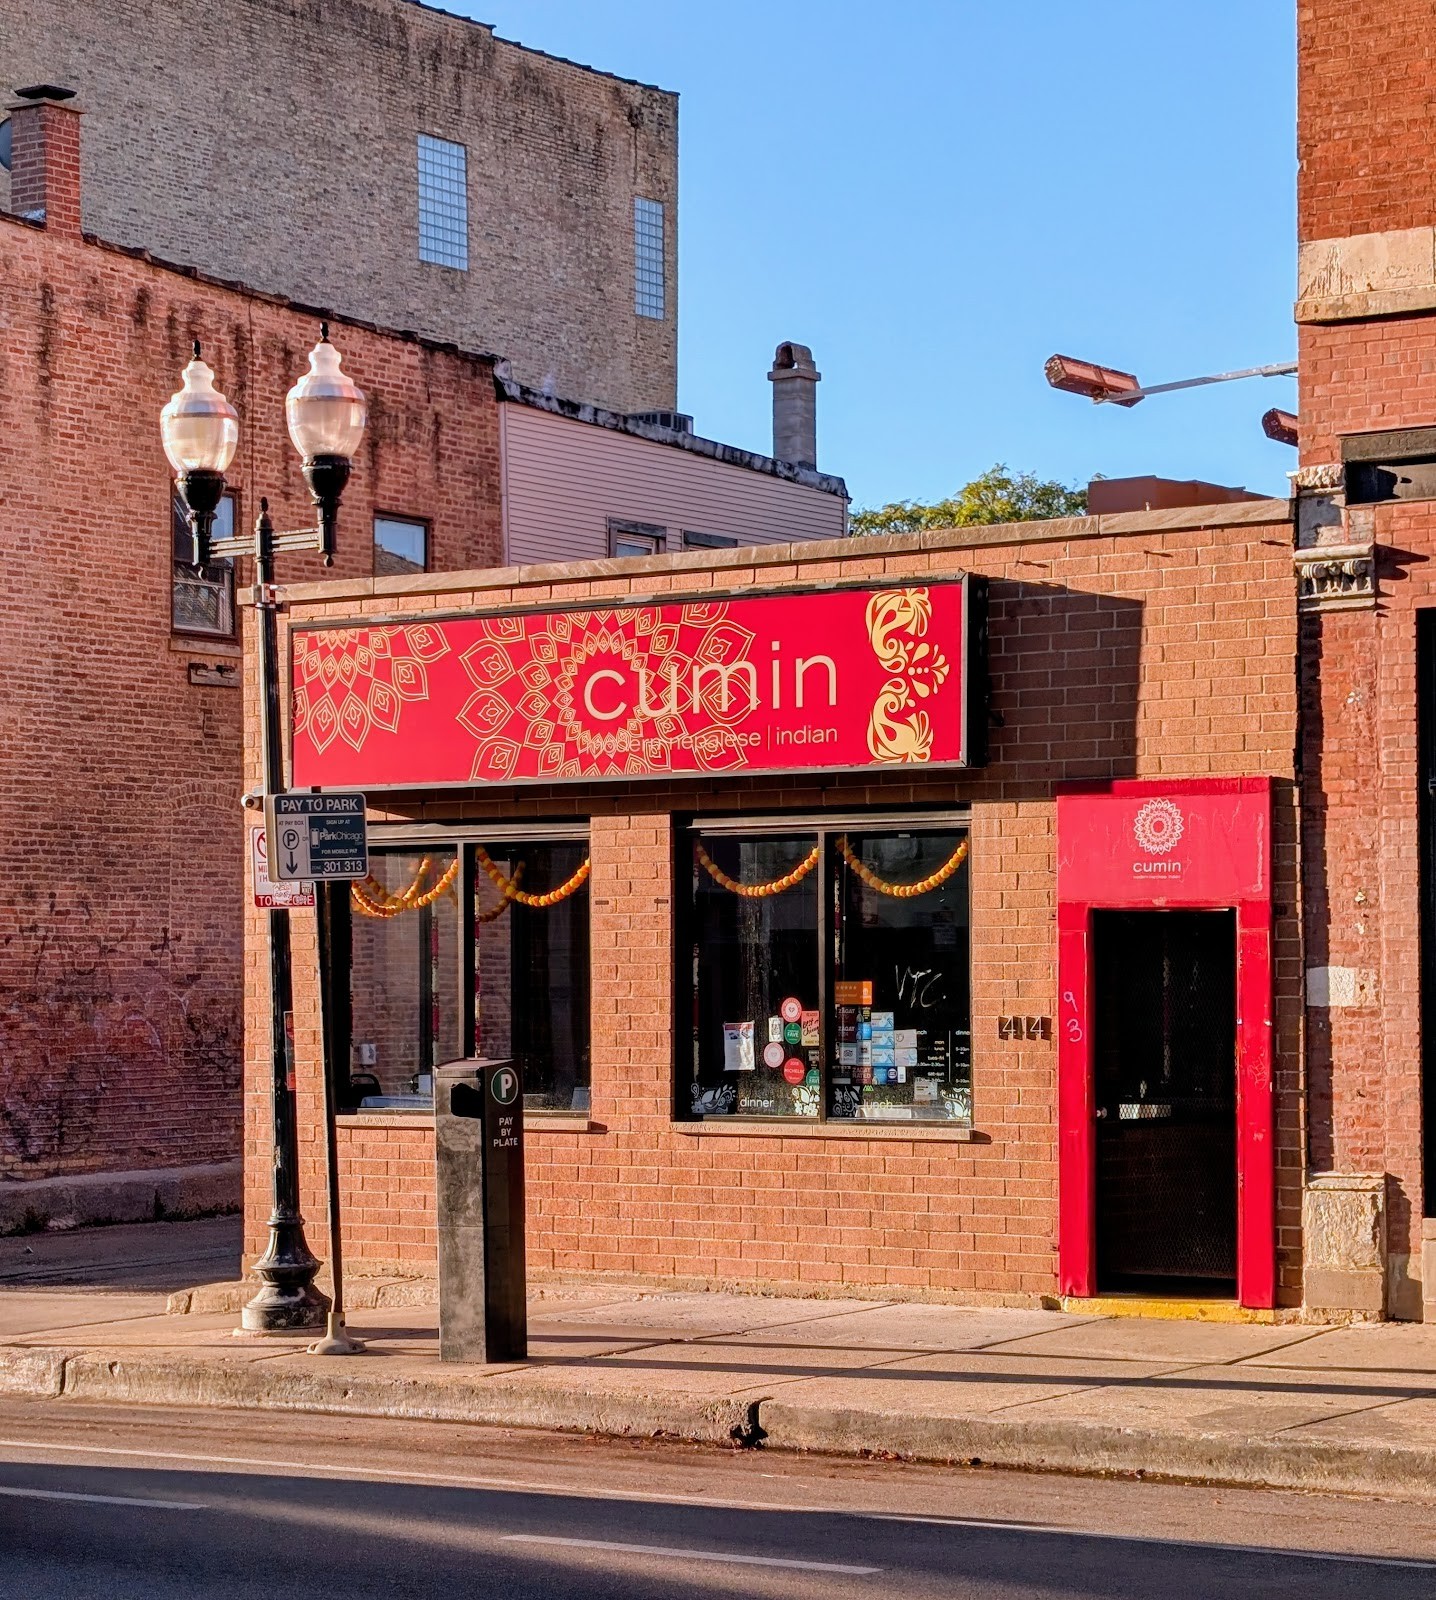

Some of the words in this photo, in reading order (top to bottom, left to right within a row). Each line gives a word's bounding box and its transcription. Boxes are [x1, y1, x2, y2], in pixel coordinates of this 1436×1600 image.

[583, 640, 838, 721] cumin
[775, 724, 838, 745] indian
[280, 799, 304, 812] PAY
[306, 798, 323, 811] TO
[326, 798, 359, 811] PARK
[319, 831, 364, 842] ParkChicago
[324, 861, 341, 872] 301
[344, 860, 363, 872] 313
[1133, 859, 1181, 873] cumin
[1066, 1018, 1083, 1043] 3
[500, 1073, 513, 1098] P
[739, 1096, 775, 1108] dinner
[499, 1117, 514, 1126] PAY
[501, 1128, 512, 1137] BY
[493, 1138, 518, 1147] PLATE
